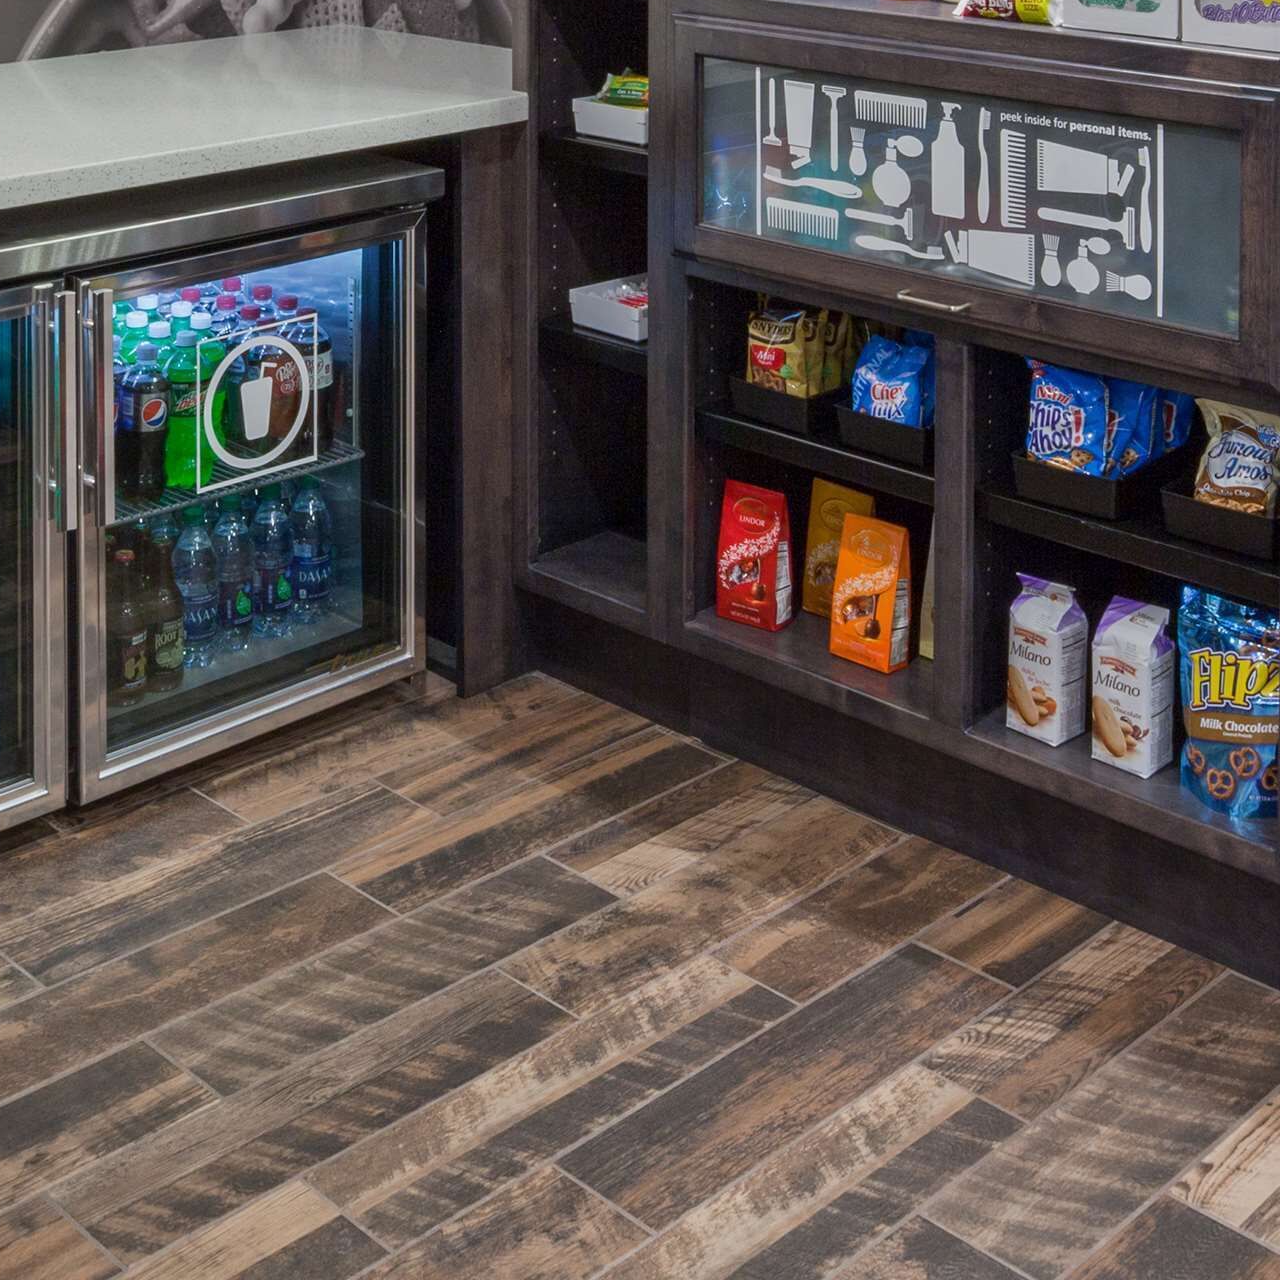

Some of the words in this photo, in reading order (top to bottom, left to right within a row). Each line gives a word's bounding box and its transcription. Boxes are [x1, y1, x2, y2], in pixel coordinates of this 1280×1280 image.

[1000, 112, 1022, 122] peek
[1025, 113, 1051, 127] inside
[1053, 117, 1068, 129] for
[1070, 122, 1115, 136] personal
[1118, 126, 1152, 141] items.
[757, 351, 775, 361] Mini
[1036, 385, 1073, 405] Mini
[1208, 432, 1273, 463] Famous
[1215, 457, 1272, 480] Amos
[740, 515, 765, 527] LINDOR
[299, 566, 331, 582] DASA
[1010, 642, 1051, 666] Milano
[1094, 670, 1140, 697] Milano
[1200, 717, 1222, 730] Milk
[1225, 720, 1279, 734] Chocolate
